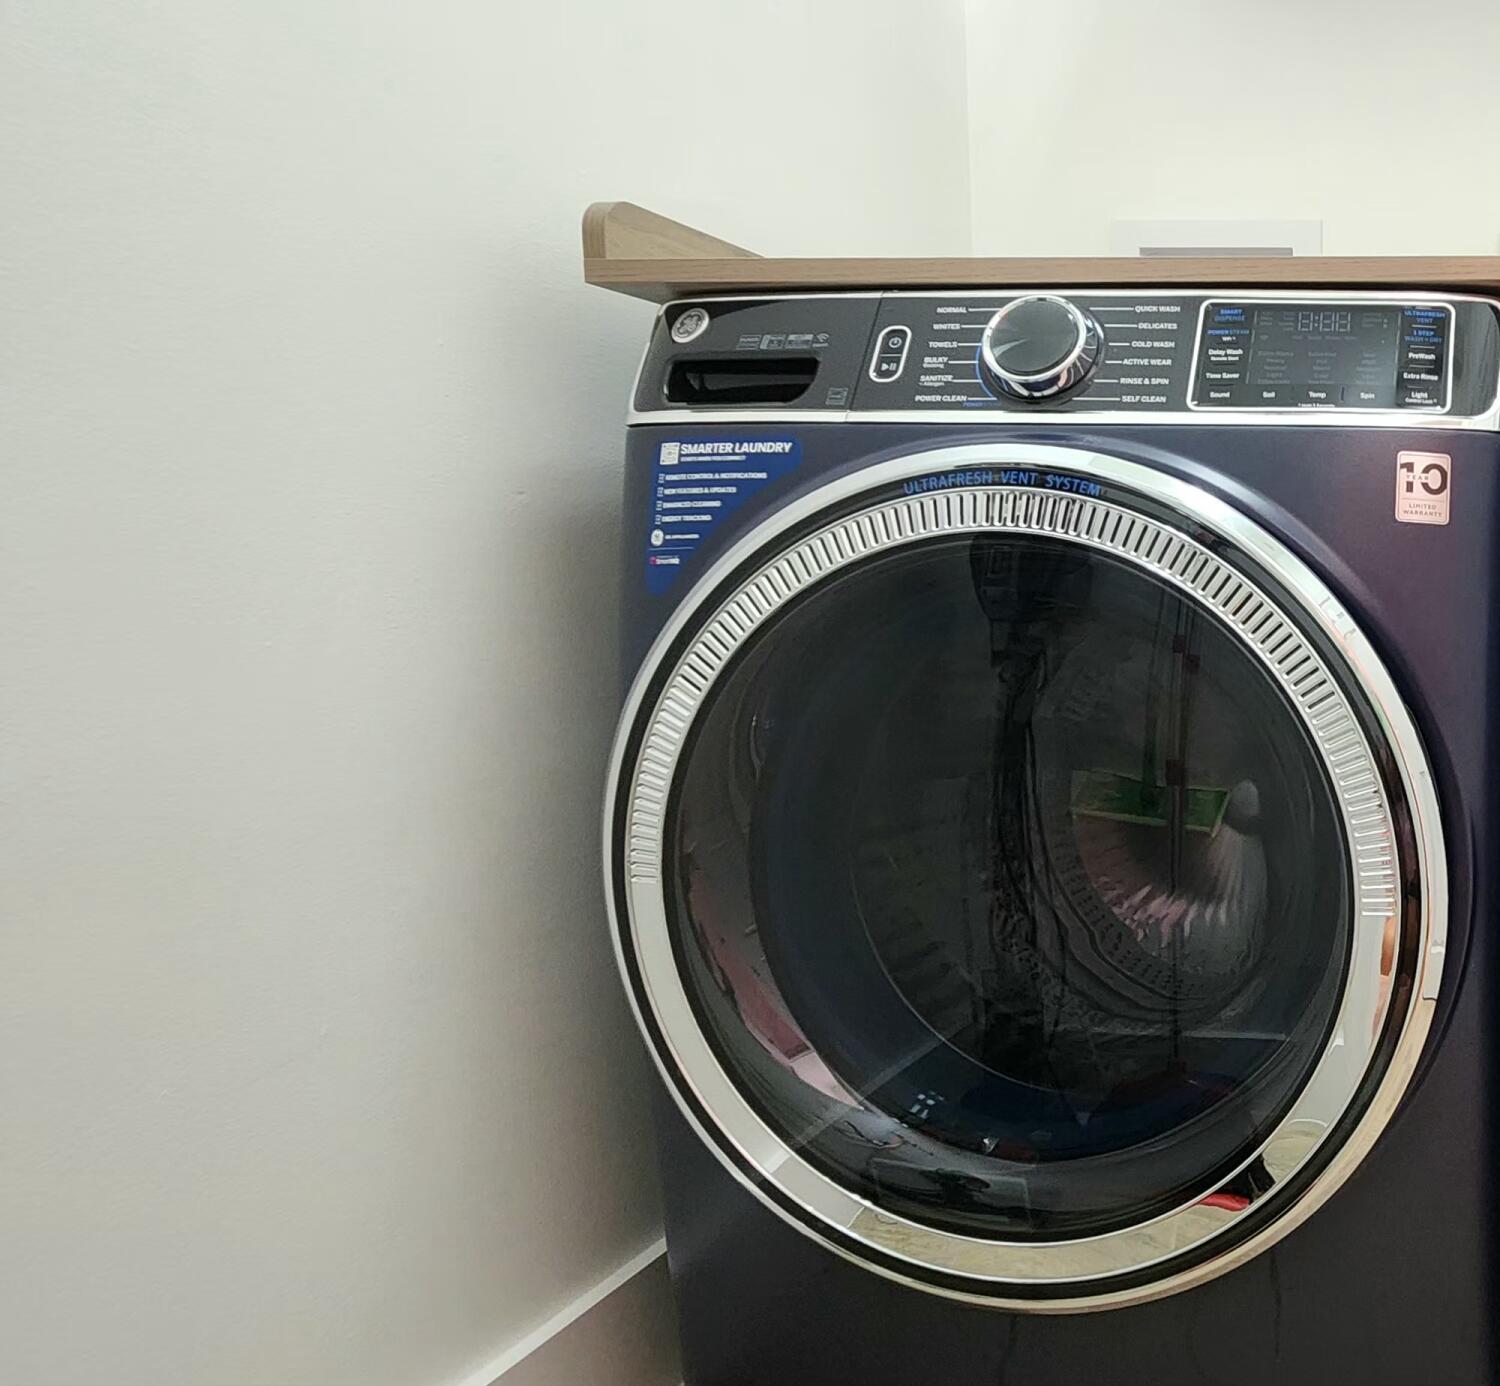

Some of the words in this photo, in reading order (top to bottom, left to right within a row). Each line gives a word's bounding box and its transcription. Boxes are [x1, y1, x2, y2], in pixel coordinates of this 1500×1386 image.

[1135, 305, 1158, 313] QUICK
[1208, 348, 1226, 356] Delay
[1408, 352, 1436, 360] PreWash
[1150, 358, 1172, 366] WEAR
[1150, 377, 1170, 385] SPIN
[1420, 373, 1438, 381] Rinse
[1141, 395, 1167, 403] CLEAN
[1308, 391, 1327, 399] Temp
[1411, 391, 1428, 399] Light
[680, 442, 734, 455] SMARTER
[734, 441, 793, 453] LAUNDRY
[1400, 462, 1448, 496] 10
[903, 471, 993, 495] ULTRAFRESH
[1000, 471, 1038, 485] VENT
[1044, 474, 1101, 496] SYSTEM
[1408, 502, 1437, 510] LIMITED
[1403, 510, 1443, 518] WARRANTY
